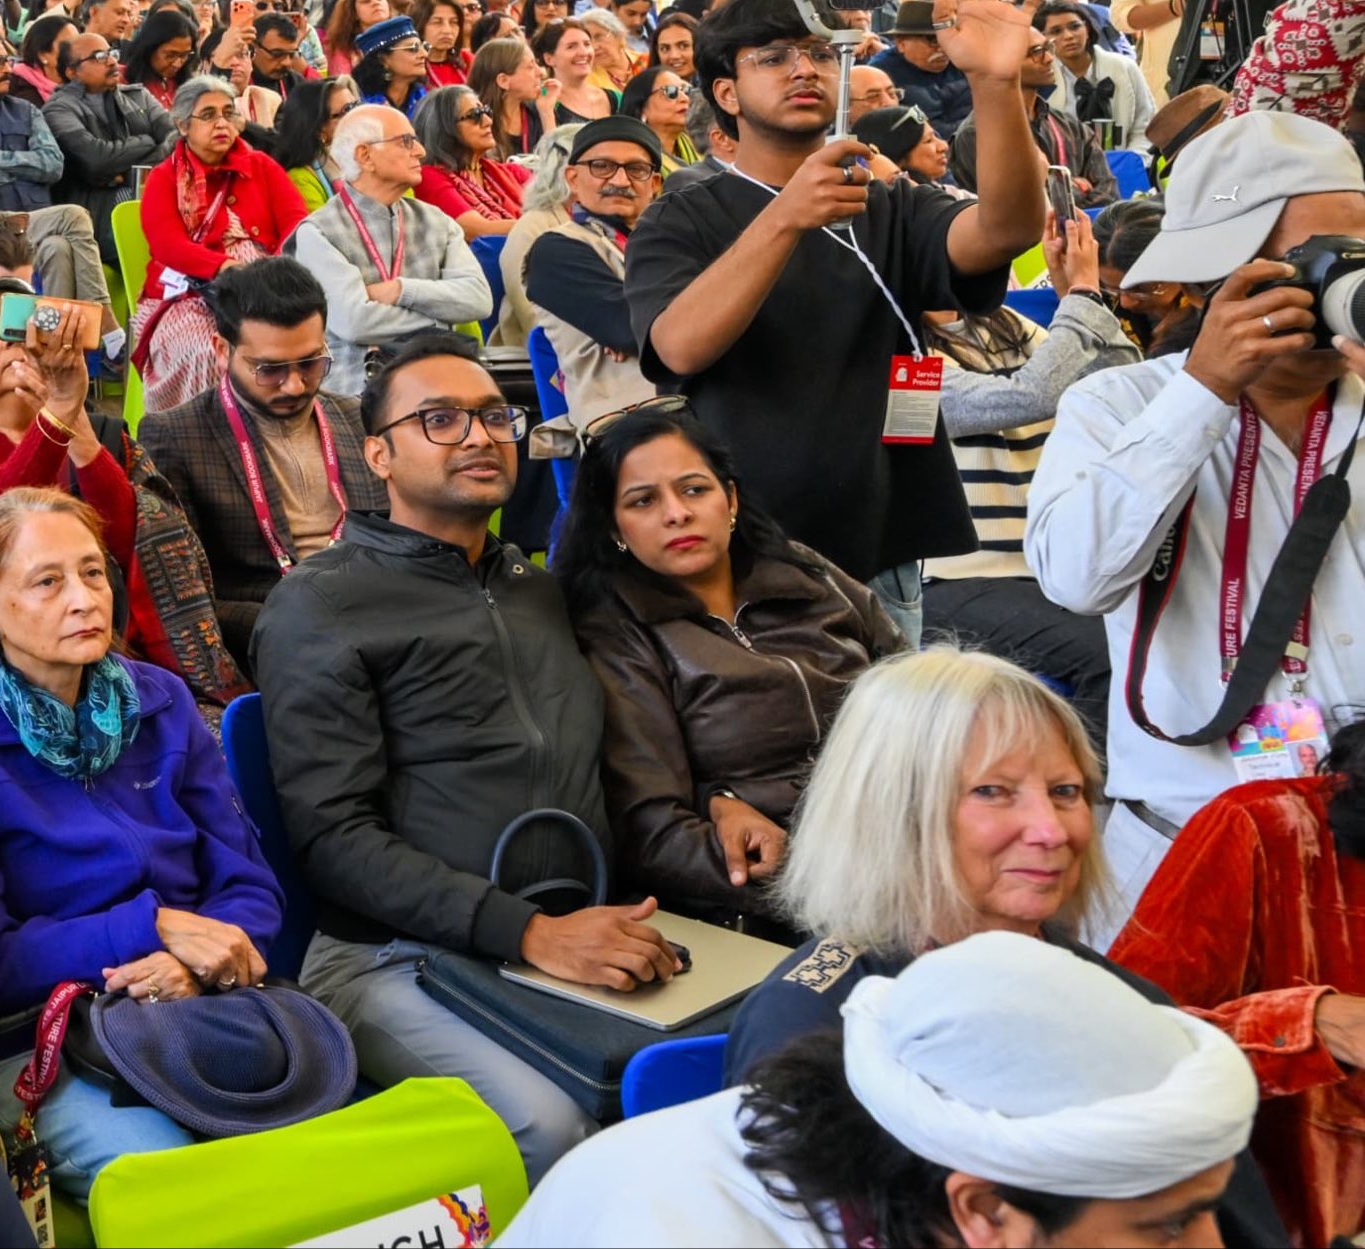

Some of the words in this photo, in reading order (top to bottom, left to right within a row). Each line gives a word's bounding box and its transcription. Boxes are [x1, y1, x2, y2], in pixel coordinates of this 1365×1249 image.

[912, 378, 939, 386] Provider
[916, 370, 940, 378] Service
[1240, 413, 1257, 468] PRESENTS
[1308, 410, 1328, 451] VEDANTA
[242, 440, 257, 479] BOOKMARK
[1300, 450, 1317, 502] PRESEN
[250, 478, 263, 503] JAIPUR
[1234, 469, 1251, 519] VEDANTA
[1152, 525, 1176, 581] Cano
[1225, 578, 1241, 634] FESTIVAL
[50, 983, 79, 1009] JAIPUR
